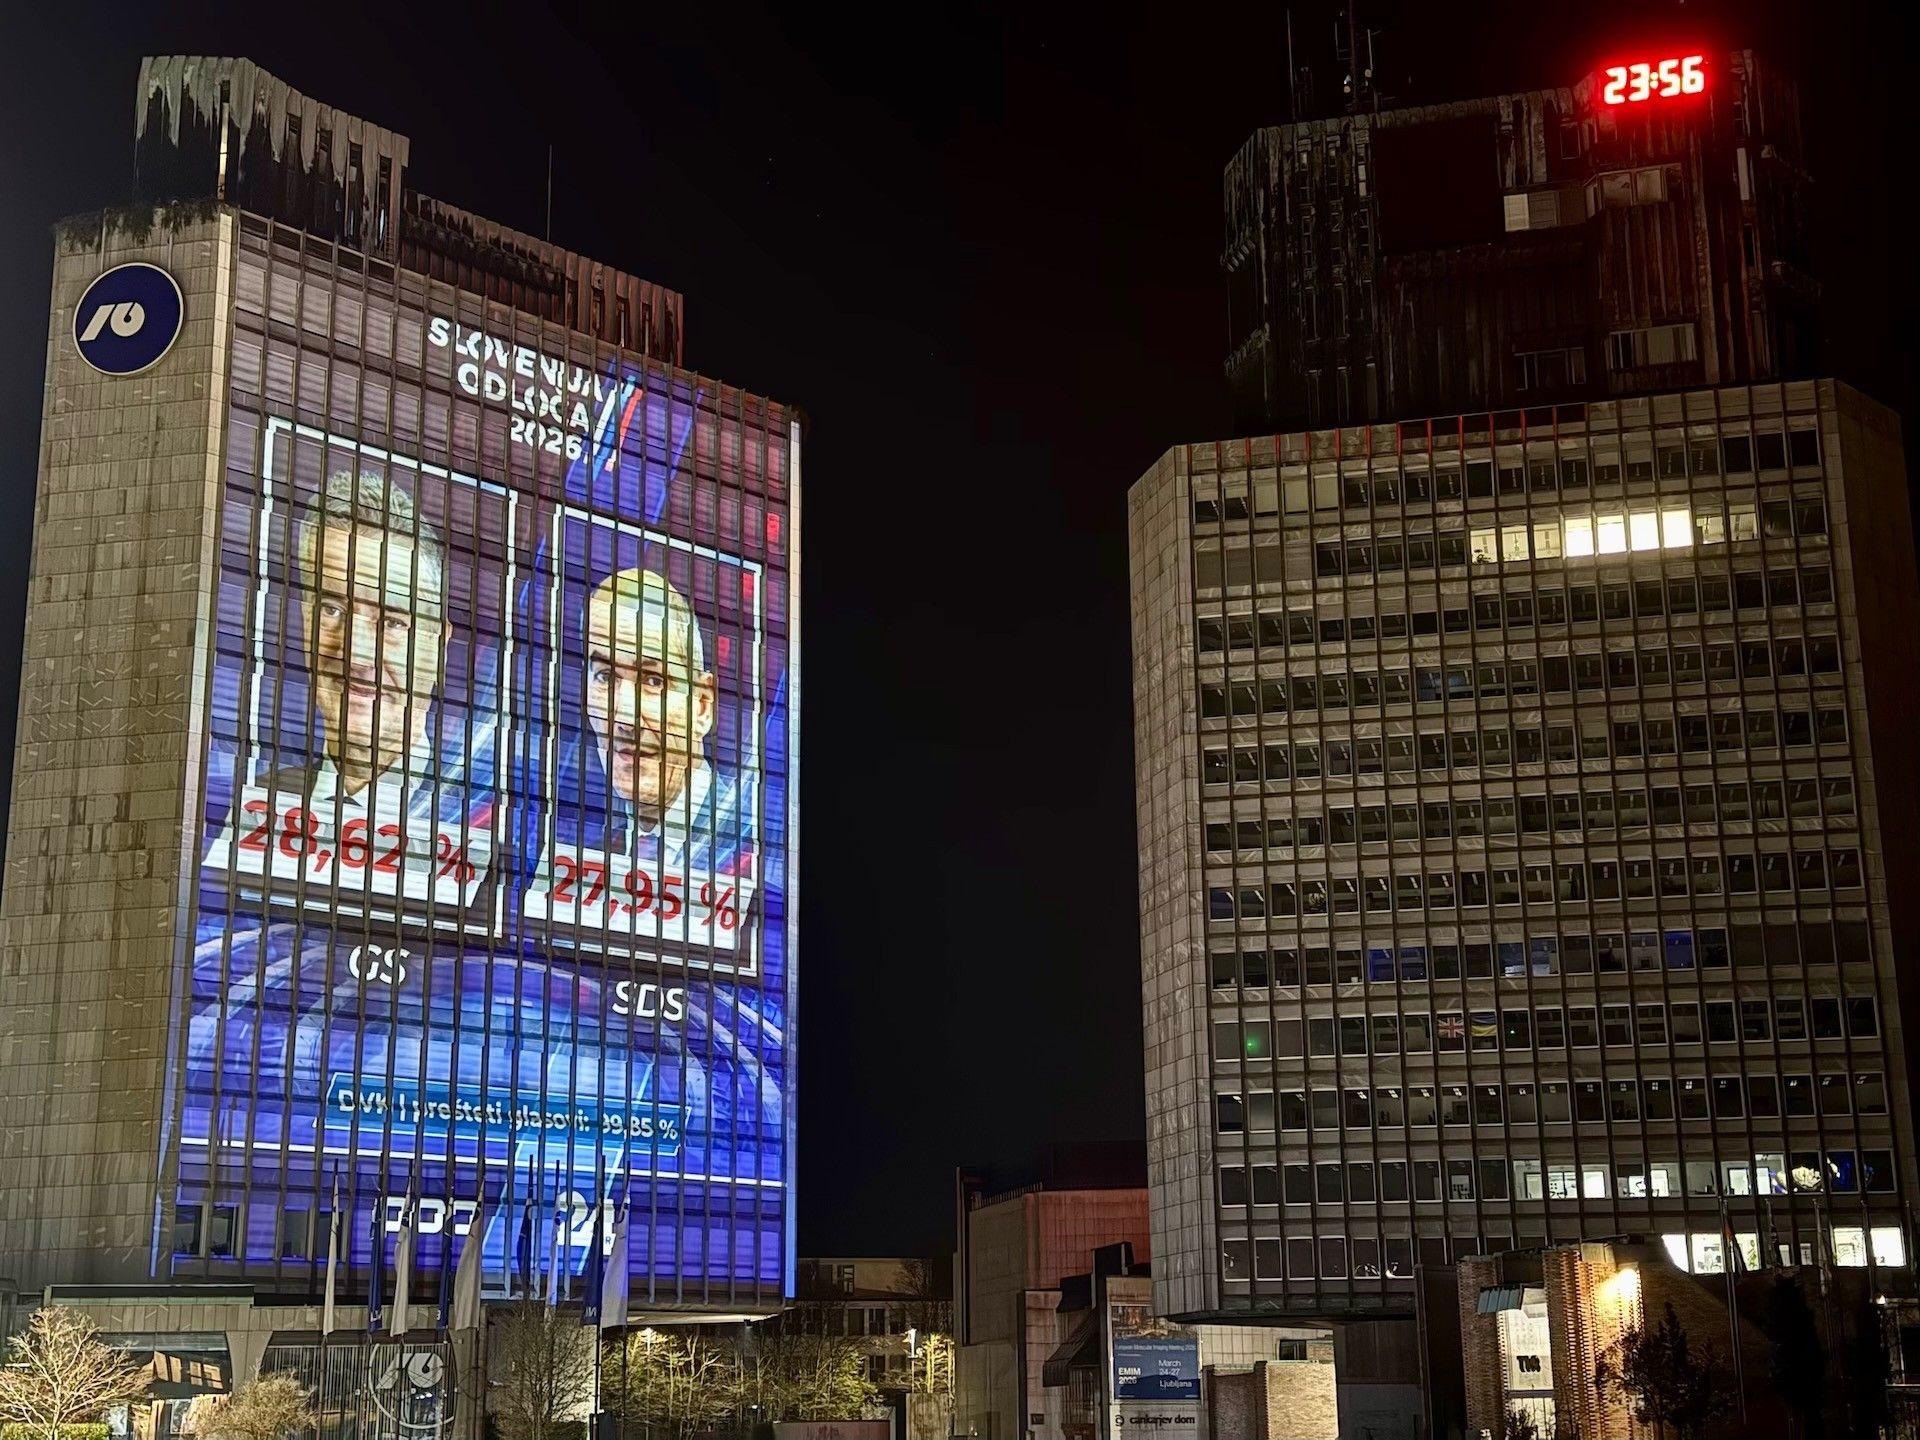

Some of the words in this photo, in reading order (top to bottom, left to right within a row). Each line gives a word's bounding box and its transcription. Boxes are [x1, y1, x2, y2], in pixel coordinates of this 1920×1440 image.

[1604, 55, 1704, 105] 23:56
[510, 415, 582, 460] 2026
[238, 799, 408, 874] 28,62
[436, 832, 476, 884] %
[552, 854, 683, 921] 27,95
[700, 880, 740, 930] %
[348, 943, 411, 985] GS
[612, 979, 689, 1022] SDS
[659, 1118, 679, 1141] %
[1118, 1367, 1141, 1376] EMIM
[1158, 1359, 1182, 1367] March
[1159, 1380, 1193, 1389] Ljubljana
[1174, 1414, 1195, 1424] dom
